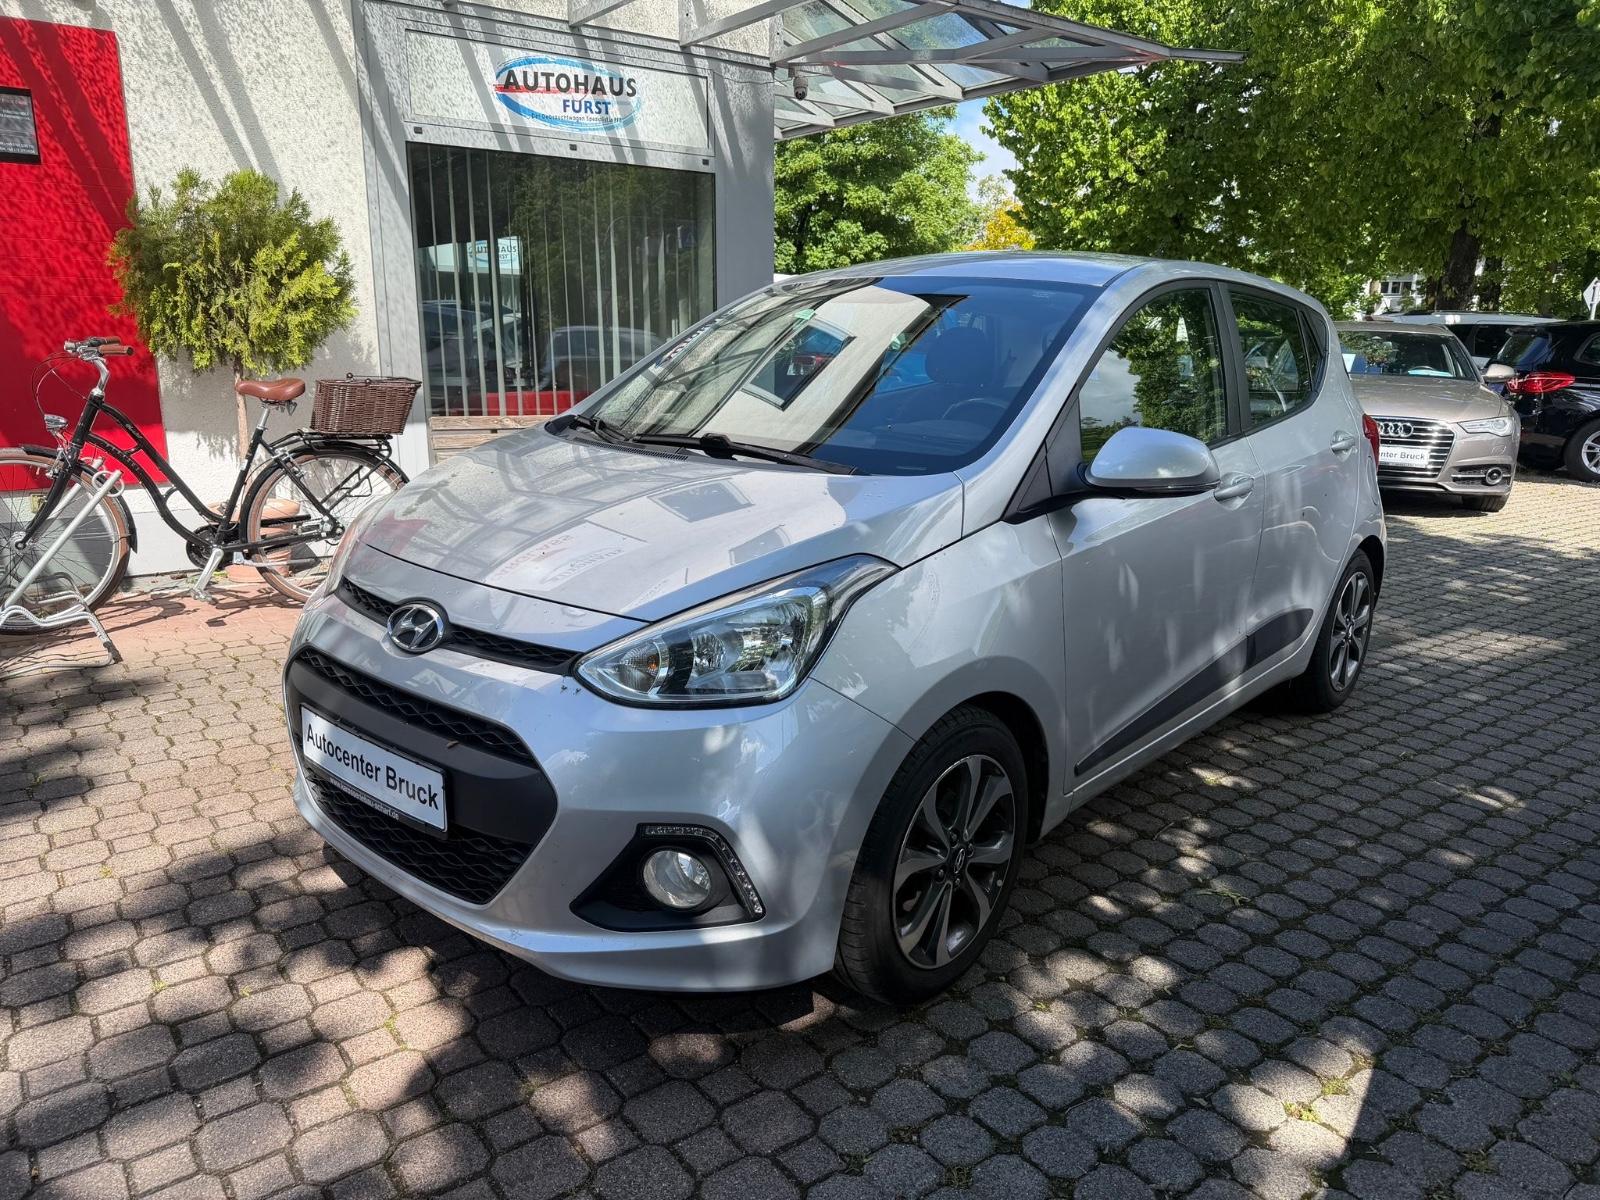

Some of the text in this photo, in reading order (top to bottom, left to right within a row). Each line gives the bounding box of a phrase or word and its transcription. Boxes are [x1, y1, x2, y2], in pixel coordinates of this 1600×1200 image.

[503, 69, 637, 97] AUTOHAUS
[306, 723, 381, 782] Autocenter
[385, 764, 440, 811] Bruck
